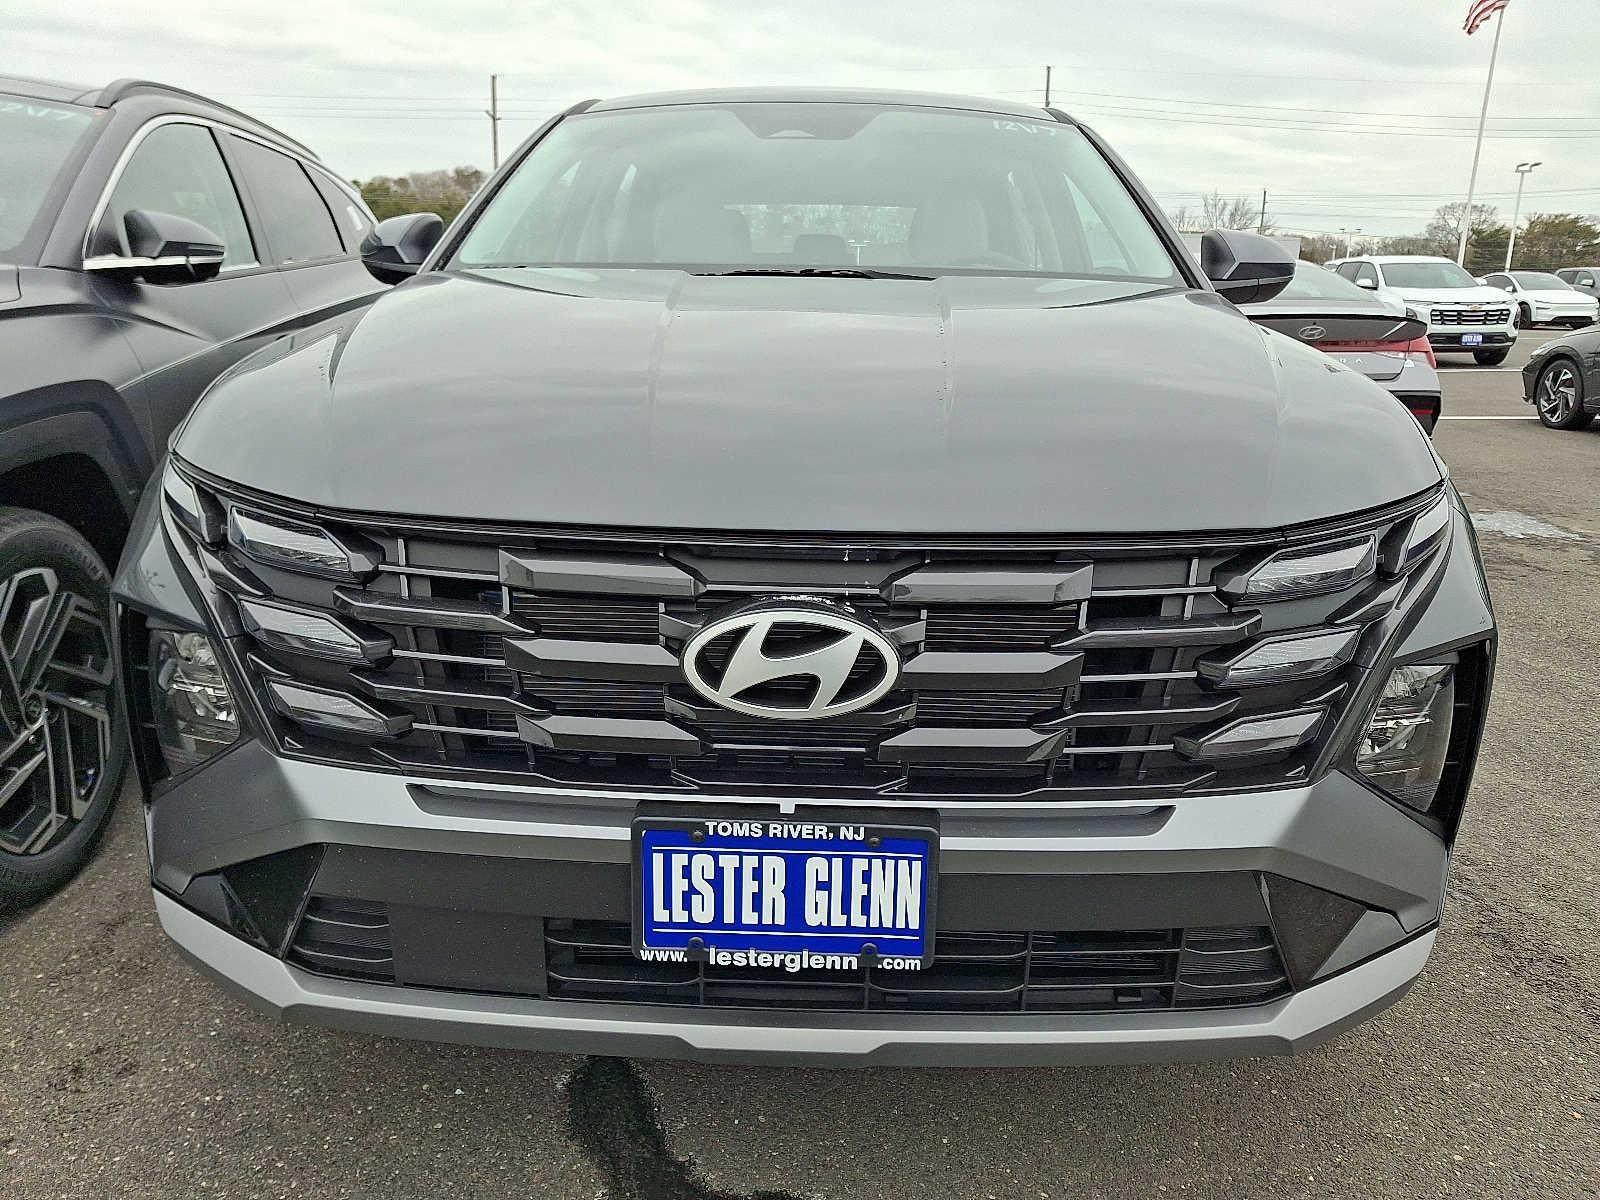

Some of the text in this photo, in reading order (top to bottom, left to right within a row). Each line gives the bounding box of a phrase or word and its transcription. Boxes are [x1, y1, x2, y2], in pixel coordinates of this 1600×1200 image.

[704, 821, 866, 841] TOMS RIVER, NJ
[652, 852, 922, 930] LESTER GLENN
[639, 947, 921, 973] www. lesterglenn .com
